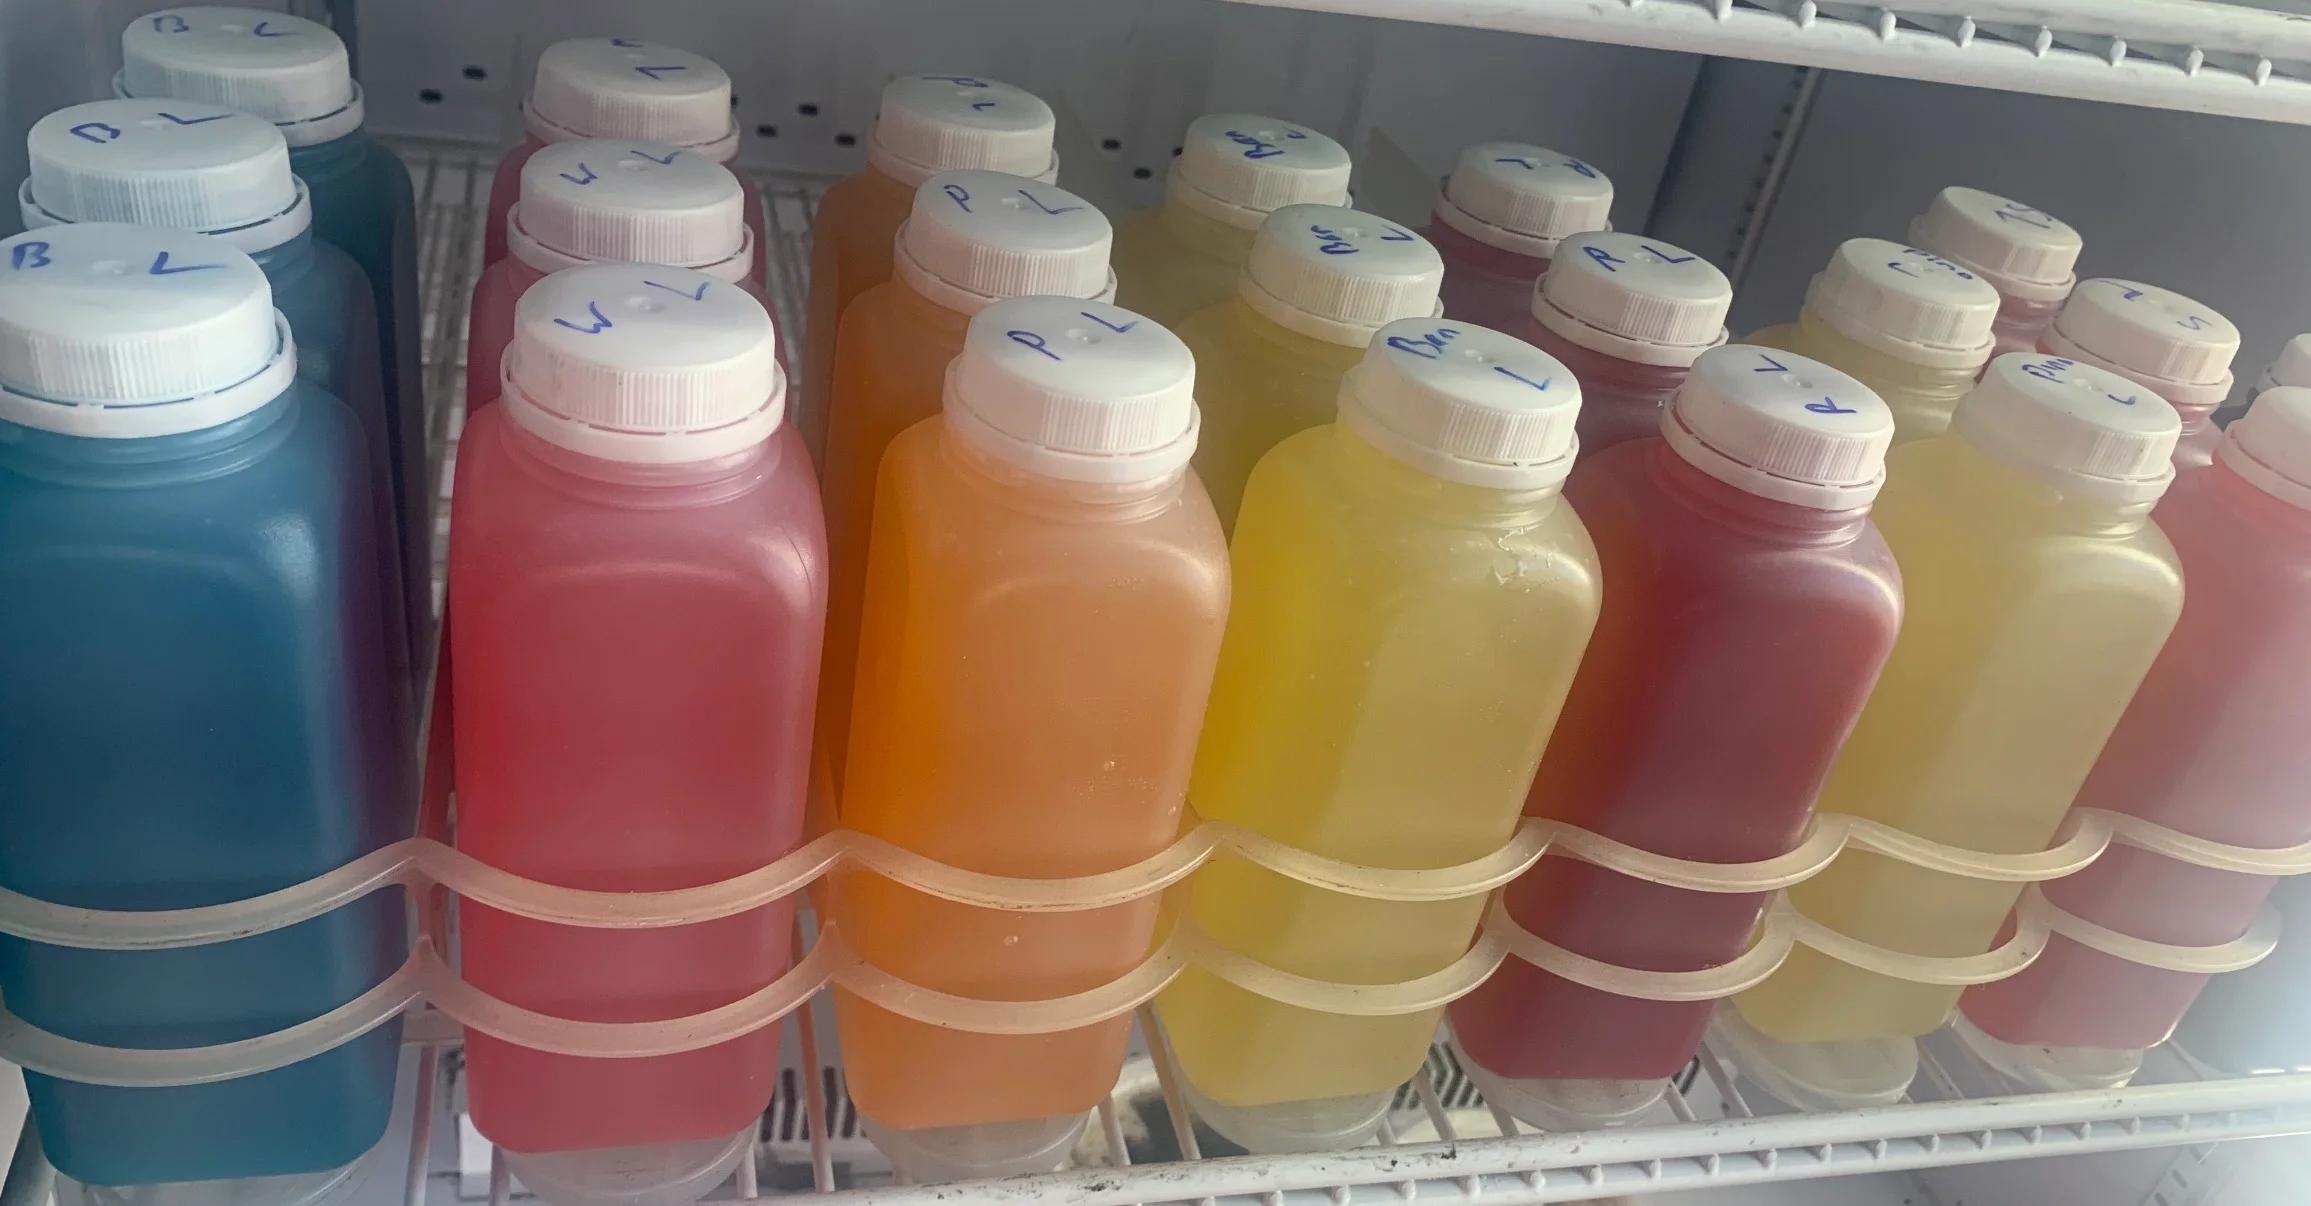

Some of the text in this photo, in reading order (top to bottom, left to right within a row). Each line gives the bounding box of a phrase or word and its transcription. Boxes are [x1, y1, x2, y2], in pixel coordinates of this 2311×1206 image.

[153, 15, 301, 38] B L
[70, 112, 237, 145] B L
[560, 149, 682, 186] W L
[943, 184, 1085, 215] P L
[1380, 224, 1415, 242] L
[11, 241, 233, 276] B L
[1582, 244, 1697, 273] R L
[553, 280, 711, 334] W L
[1006, 310, 1140, 362] P L
[1493, 366, 1553, 392] L
[1753, 353, 1858, 415] R L
